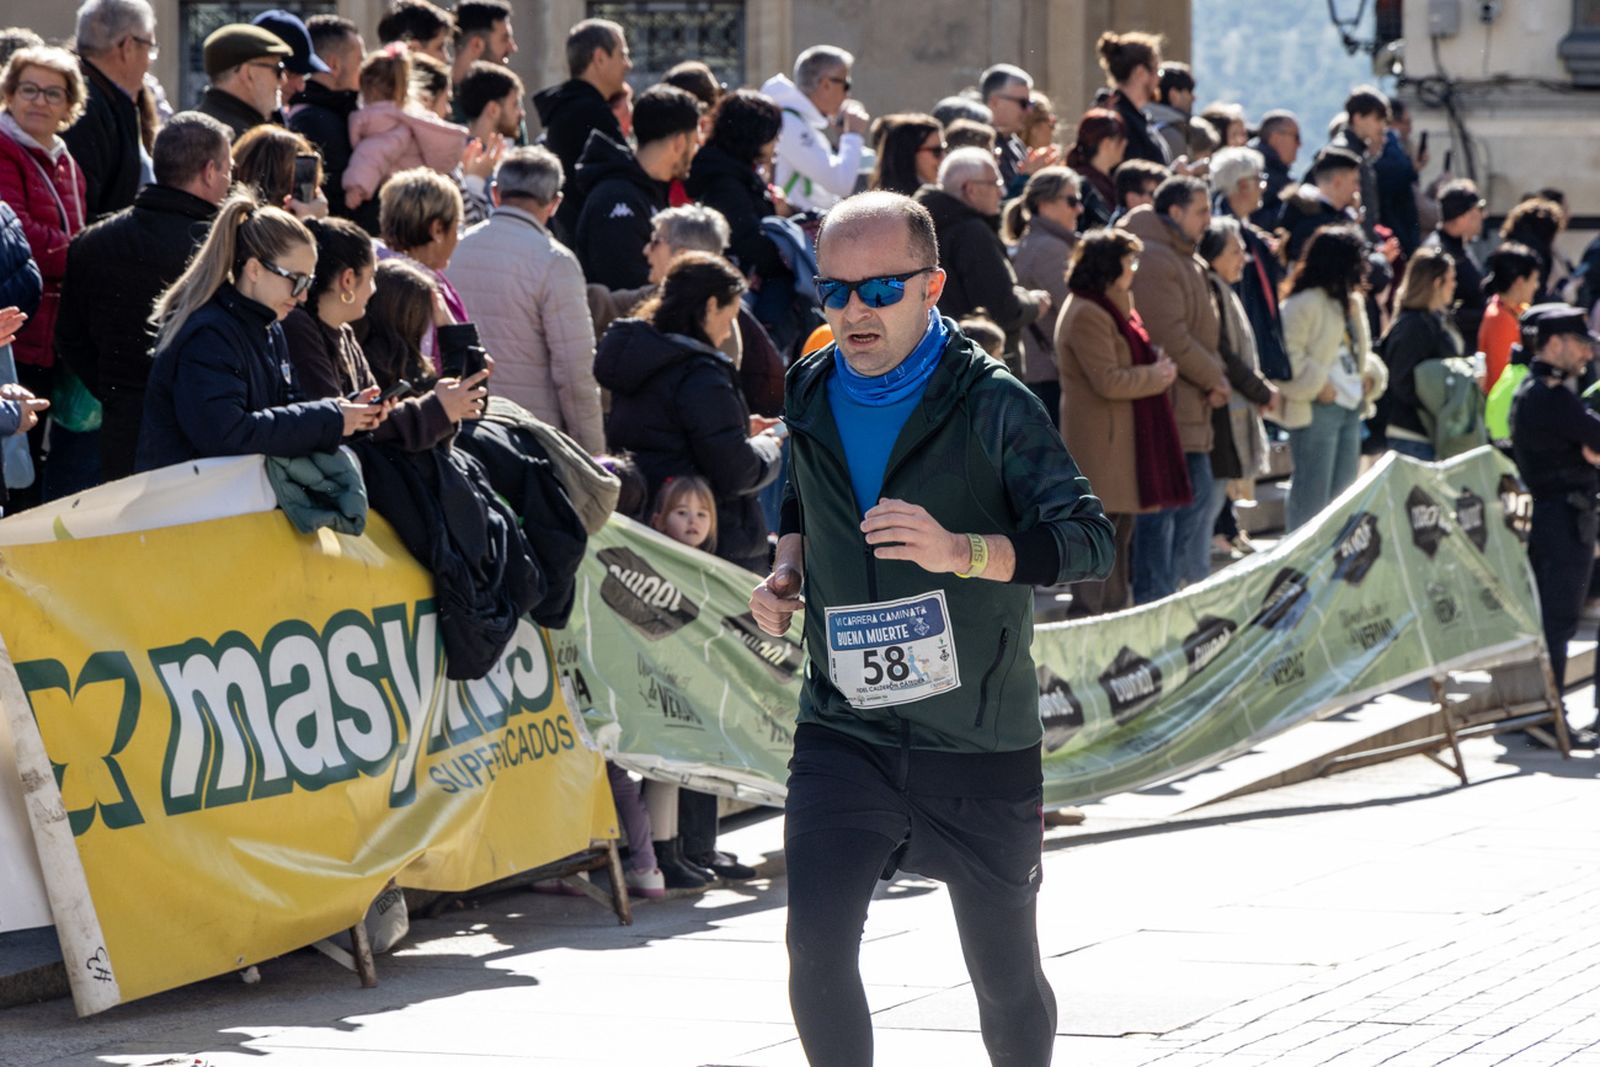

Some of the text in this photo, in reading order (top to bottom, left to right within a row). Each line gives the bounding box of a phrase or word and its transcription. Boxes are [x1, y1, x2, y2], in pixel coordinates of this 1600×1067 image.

[843, 614, 878, 626] CARRERA
[880, 605, 927, 622] CAMINATA
[837, 624, 909, 646] BUENA MUERTE
[863, 646, 910, 686] 58
[150, 612, 554, 814] masys
